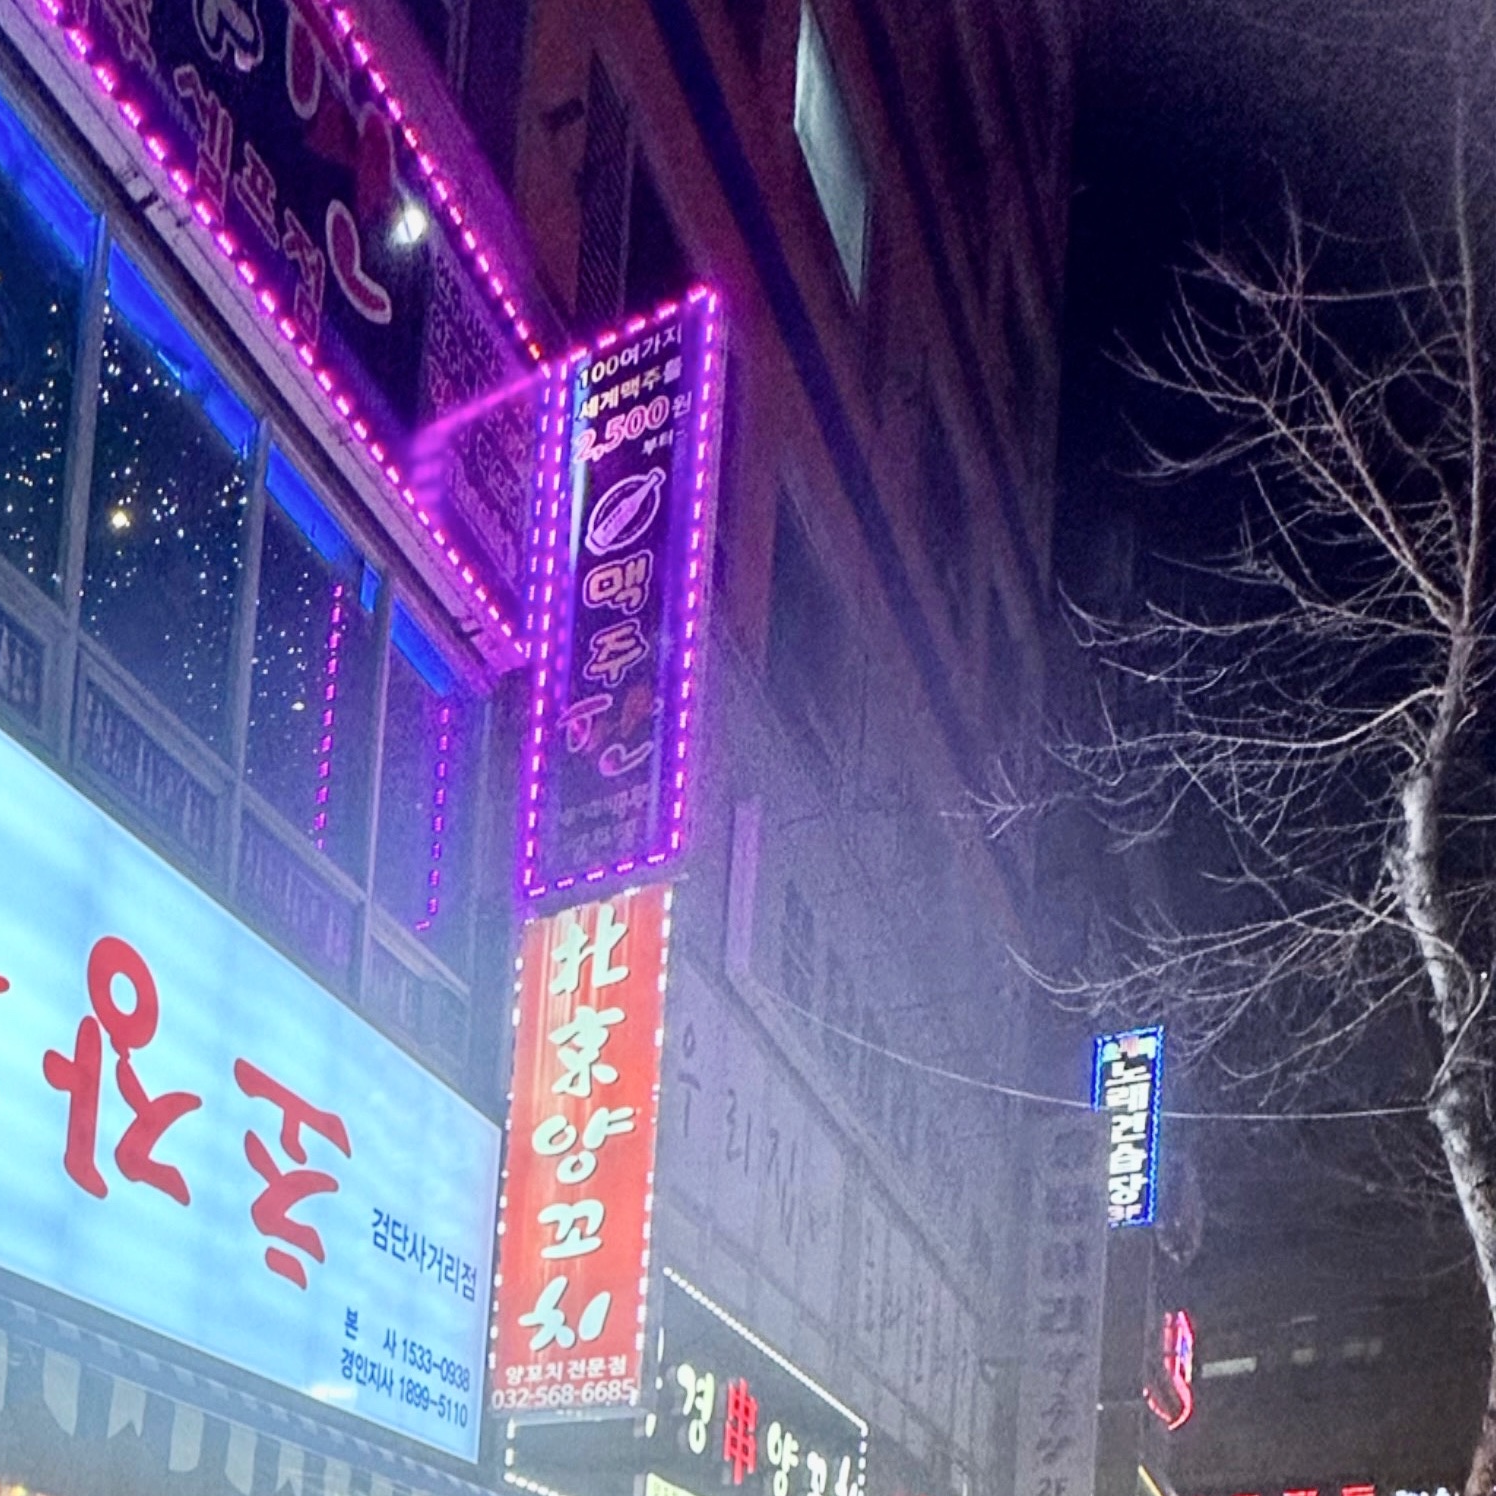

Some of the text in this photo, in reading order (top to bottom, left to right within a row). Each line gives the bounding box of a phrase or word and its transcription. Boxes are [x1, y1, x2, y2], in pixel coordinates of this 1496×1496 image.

[577, 325, 683, 389] 100여가지
[371, 1207, 478, 1301] 검단사거리점
[340, 1348, 469, 1429] 경인지사 1899-5110
[401, 1337, 471, 1393] 1533-0938
[492, 1378, 636, 1411] 032-568-6685
[505, 1355, 628, 1386] 양꼬치 전문점
